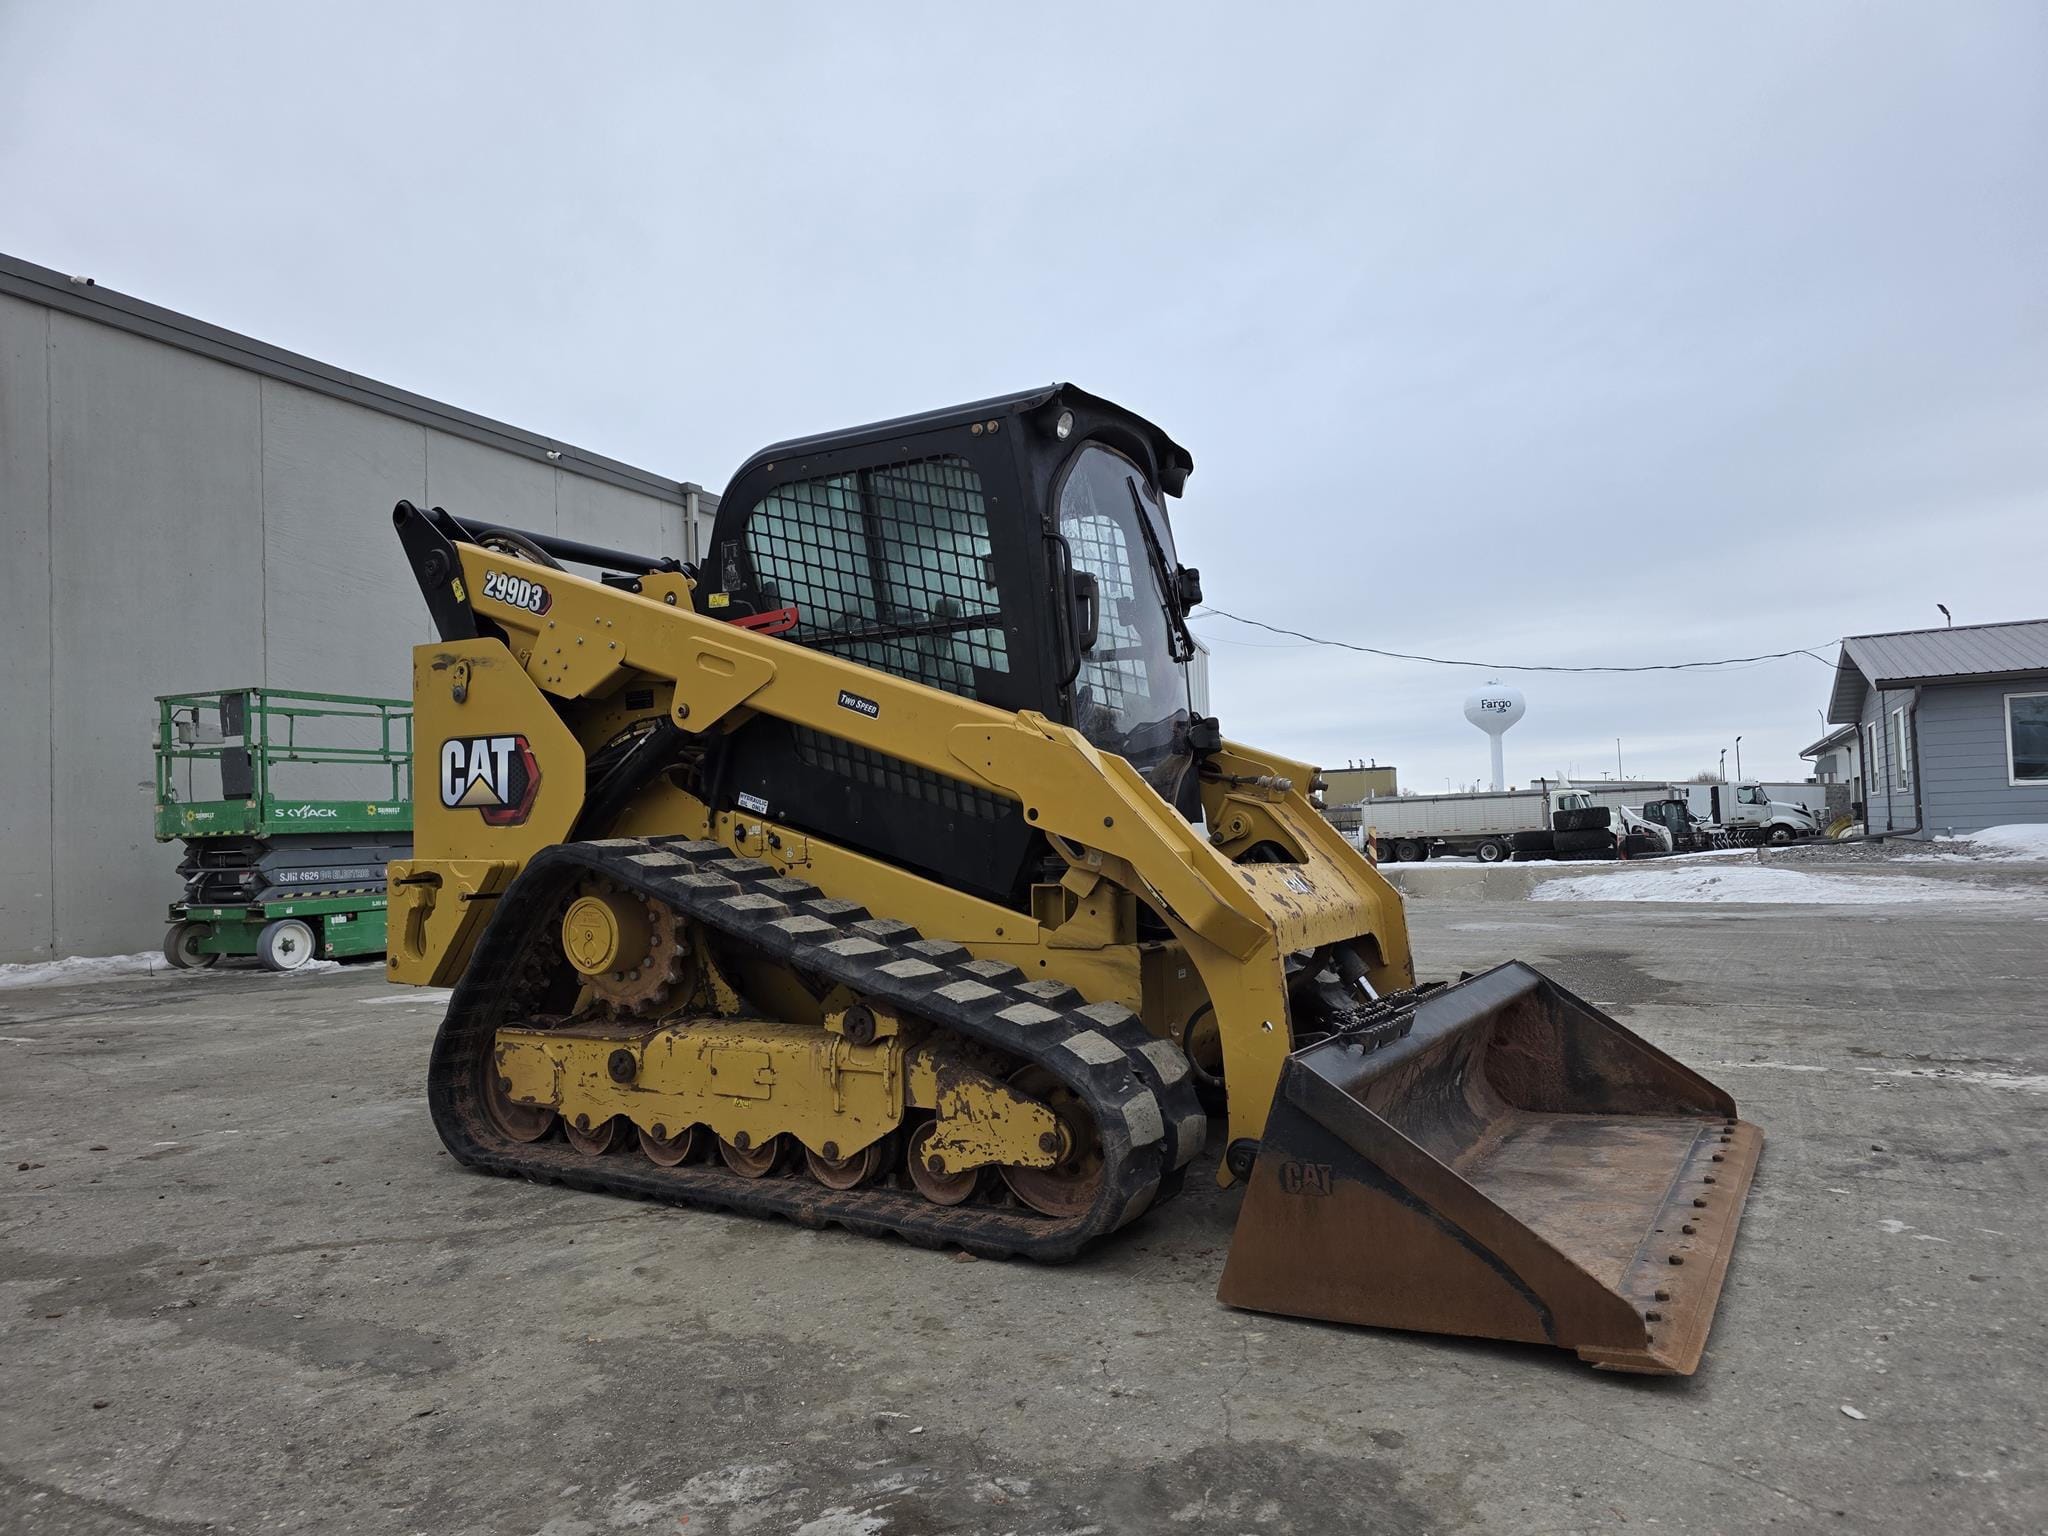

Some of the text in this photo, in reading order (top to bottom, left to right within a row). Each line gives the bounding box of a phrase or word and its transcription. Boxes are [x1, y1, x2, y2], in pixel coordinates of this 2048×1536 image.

[483, 570, 543, 612] 299D3
[1481, 699, 1512, 713] Fargo
[441, 737, 516, 806] CAT
[1283, 1161, 1333, 1194] CAT
